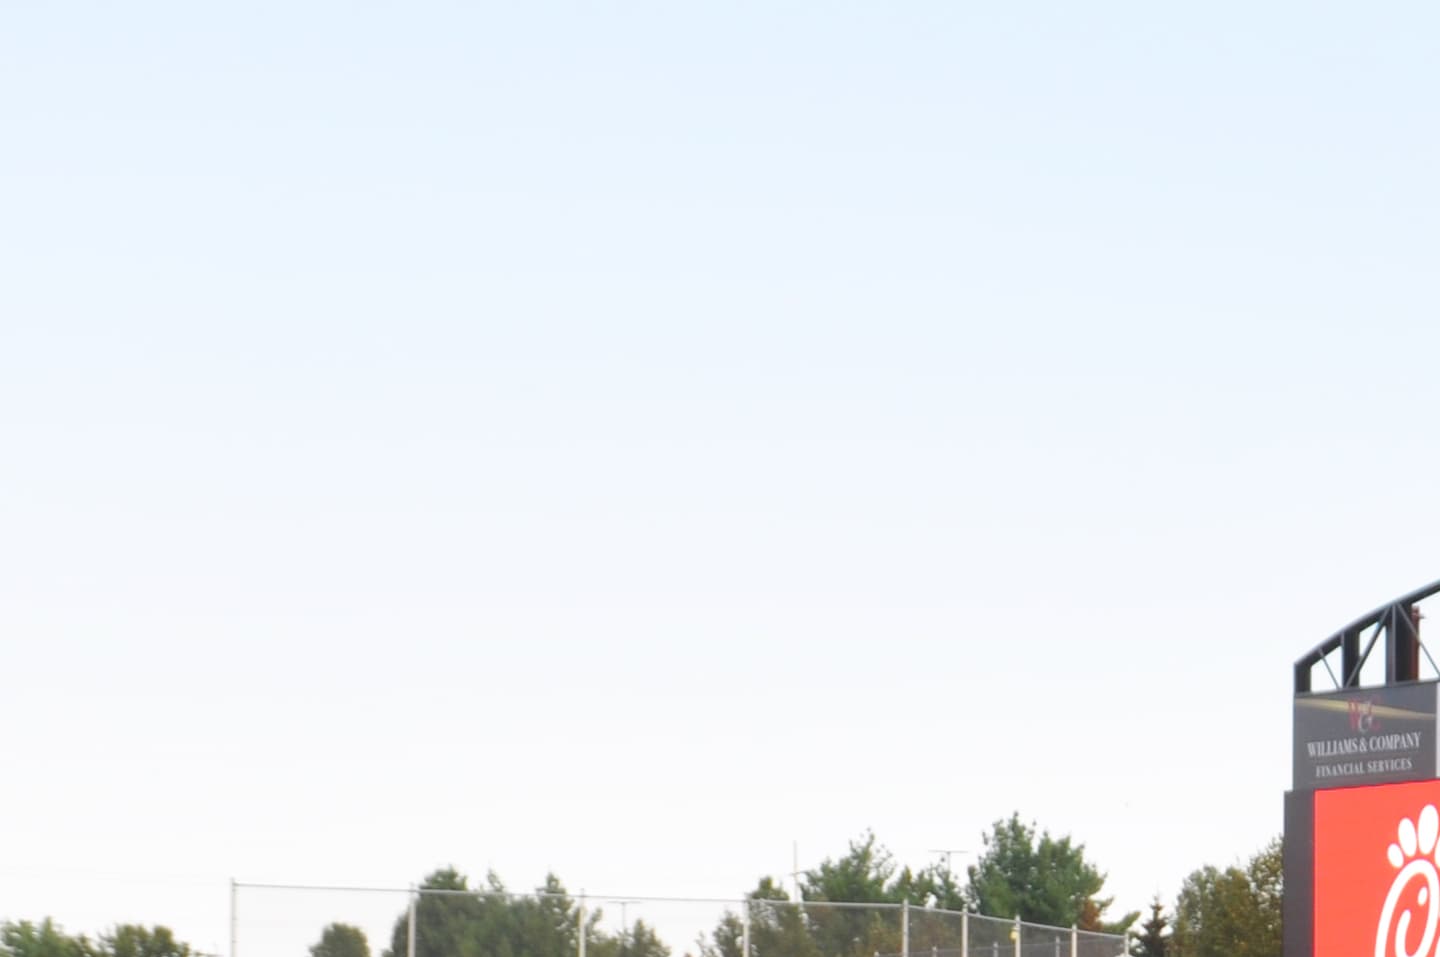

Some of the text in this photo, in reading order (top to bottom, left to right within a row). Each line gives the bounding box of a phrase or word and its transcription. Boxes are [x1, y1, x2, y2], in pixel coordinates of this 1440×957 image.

[1307, 731, 1421, 757] WILLIAMS & COMPANY
[1315, 757, 1413, 777] FINANCIAL SERVICES
